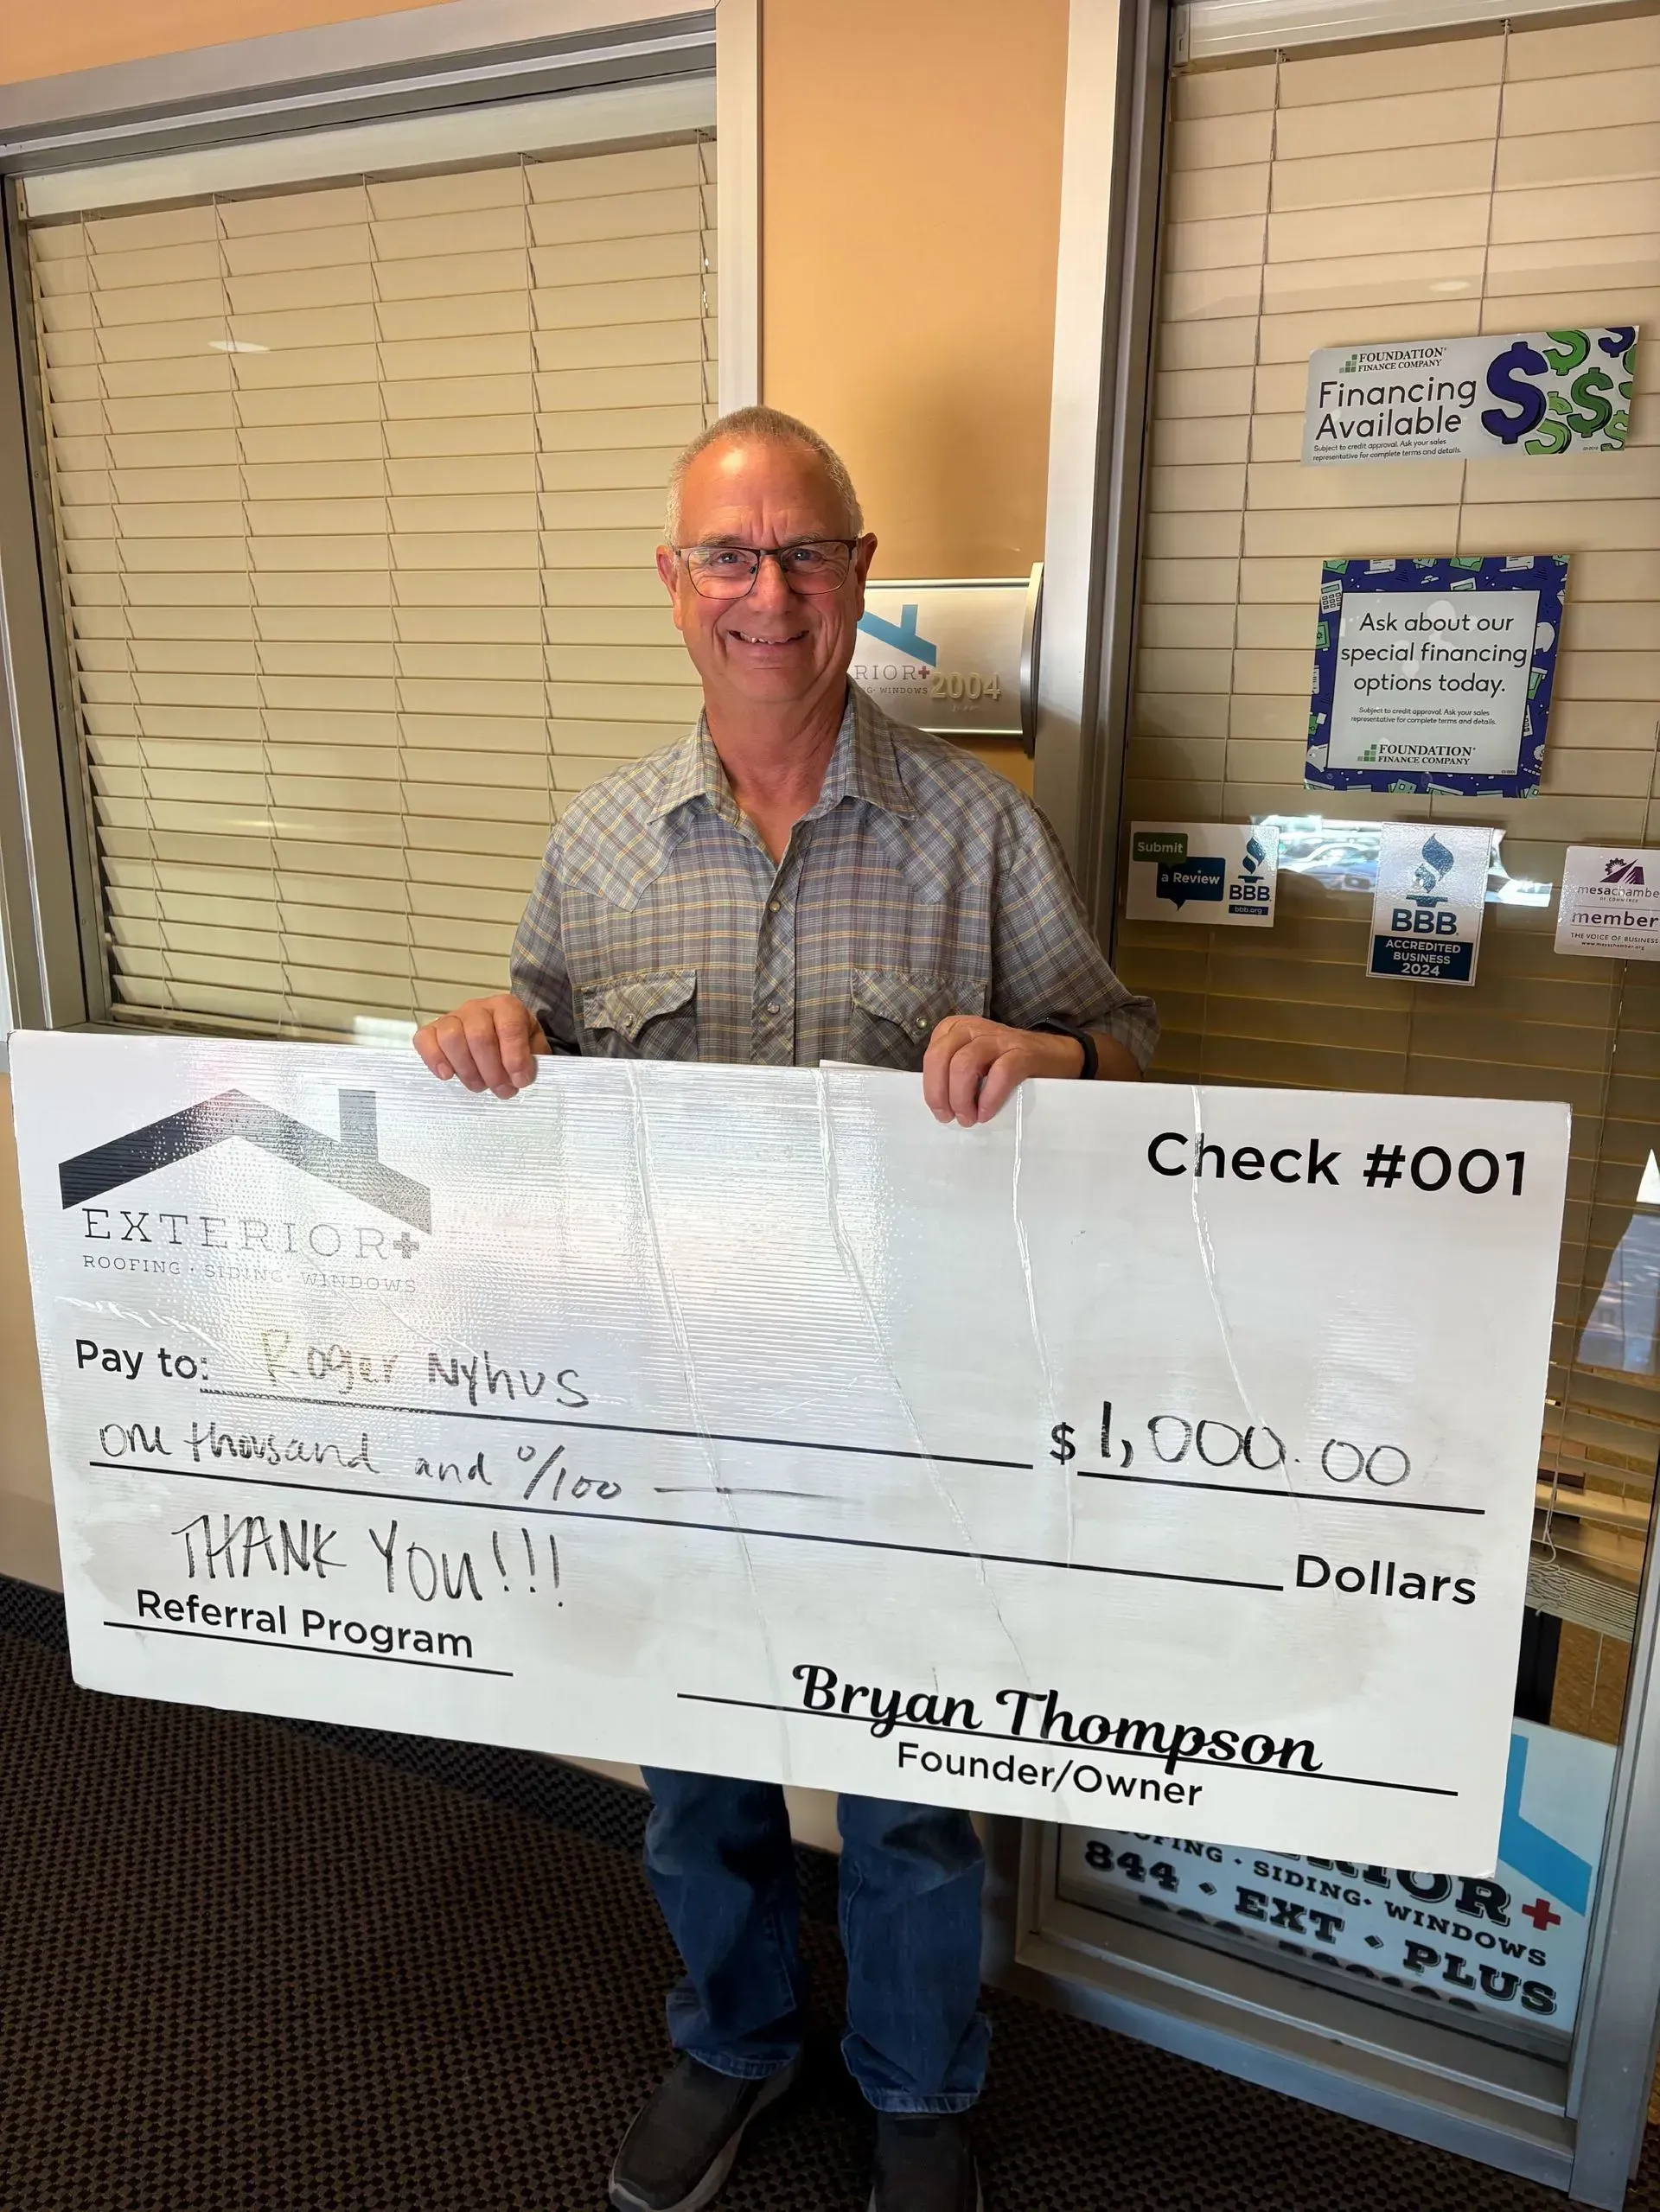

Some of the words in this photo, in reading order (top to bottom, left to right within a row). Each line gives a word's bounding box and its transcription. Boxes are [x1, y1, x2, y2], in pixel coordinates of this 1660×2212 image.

[1358, 362, 1396, 373] FINANCE
[1398, 359, 1442, 368] COMPANY
[1359, 347, 1443, 363] FOUNDATION
[1319, 376, 1477, 409] Financing
[1315, 405, 1462, 441] Available
[1312, 453, 1358, 462] representative
[1370, 450, 1401, 460] complete
[1313, 444, 1338, 453] Subject
[1359, 612, 1398, 631] Ask
[1404, 612, 1470, 632] about
[1477, 617, 1514, 632] our
[1340, 642, 1414, 666] special
[1421, 642, 1528, 668] financing
[931, 673, 1001, 699] 2004
[1354, 673, 1432, 696] options
[1438, 673, 1506, 698] today.
[1378, 744, 1473, 756] FOUNDATION
[1378, 755, 1420, 764] FINANCE
[1422, 756, 1470, 766] COMPANY
[1137, 842, 1184, 854] Submit
[1173, 870, 1221, 884] Review
[1229, 884, 1271, 902] BBB
[1235, 906, 1262, 915] bbb.org
[1391, 908, 1459, 935] BBB
[1572, 911, 1659, 928] member
[1385, 940, 1461, 953] ACCREDITED
[1393, 952, 1452, 965] BUSINESS
[1401, 963, 1440, 977] 2024
[1146, 1131, 1342, 1187] Check
[1363, 1144, 1526, 1196] #001
[83, 1255, 182, 1275] ROOFING
[205, 1264, 284, 1284] SIDING
[301, 1272, 417, 1293] WINDOWS
[76, 1339, 144, 1380] Pay
[157, 1348, 208, 1380] to:
[183, 1421, 380, 1474] thousand
[415, 1452, 492, 1485] and
[171, 1514, 347, 1578] THANK
[1297, 1553, 1477, 1605] Dollars
[137, 1589, 286, 1635] Referral
[301, 1609, 473, 1658] Program
[792, 1663, 982, 1738] Bryan
[995, 1689, 1324, 1775] Thompson
[898, 1743, 1203, 1807] Founder/Owner
[1254, 1860, 1361, 1906] SIDING
[1384, 1901, 1546, 1967] WINDOWS
[1085, 1840, 1179, 1893] 844
[1235, 1885, 1345, 1944] EXT
[1402, 1939, 1556, 2015] PLUS
